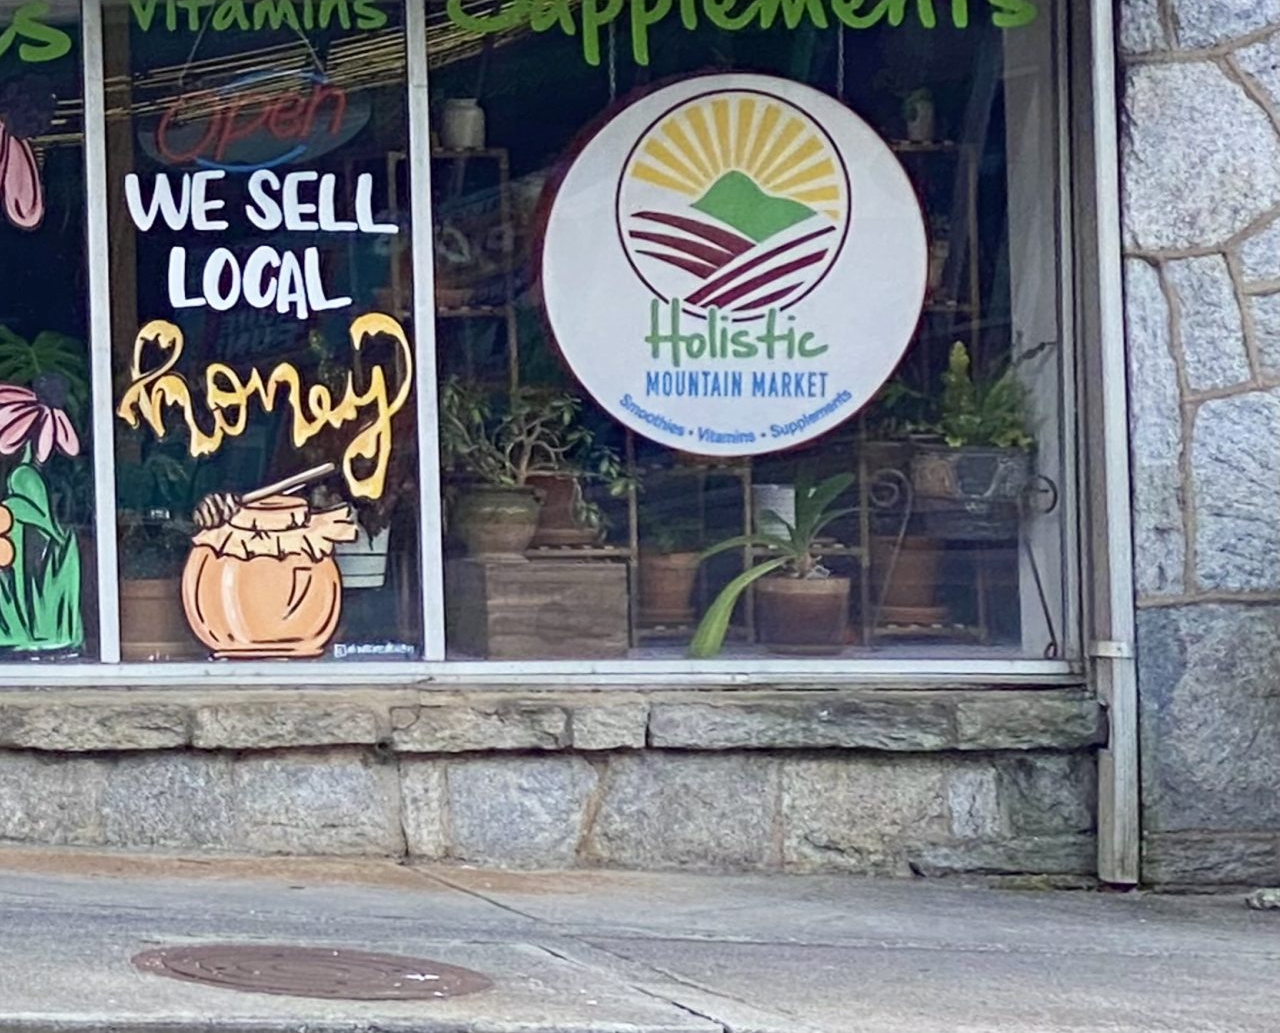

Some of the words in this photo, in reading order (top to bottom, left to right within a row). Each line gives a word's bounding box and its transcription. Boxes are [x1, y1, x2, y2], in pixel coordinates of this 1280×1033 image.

[155, 78, 348, 163] Open
[125, 169, 226, 232] WE
[246, 171, 399, 234] SELL
[168, 246, 352, 319] LOCAL
[644, 297, 829, 367] Holistic
[116, 312, 414, 499] honey
[619, 393, 686, 437] Smoothies
[697, 426, 756, 443] Vitamins
[770, 389, 853, 439] Supplements
[646, 371, 742, 397] MOUNTAIN
[752, 371, 829, 398] MARKET
